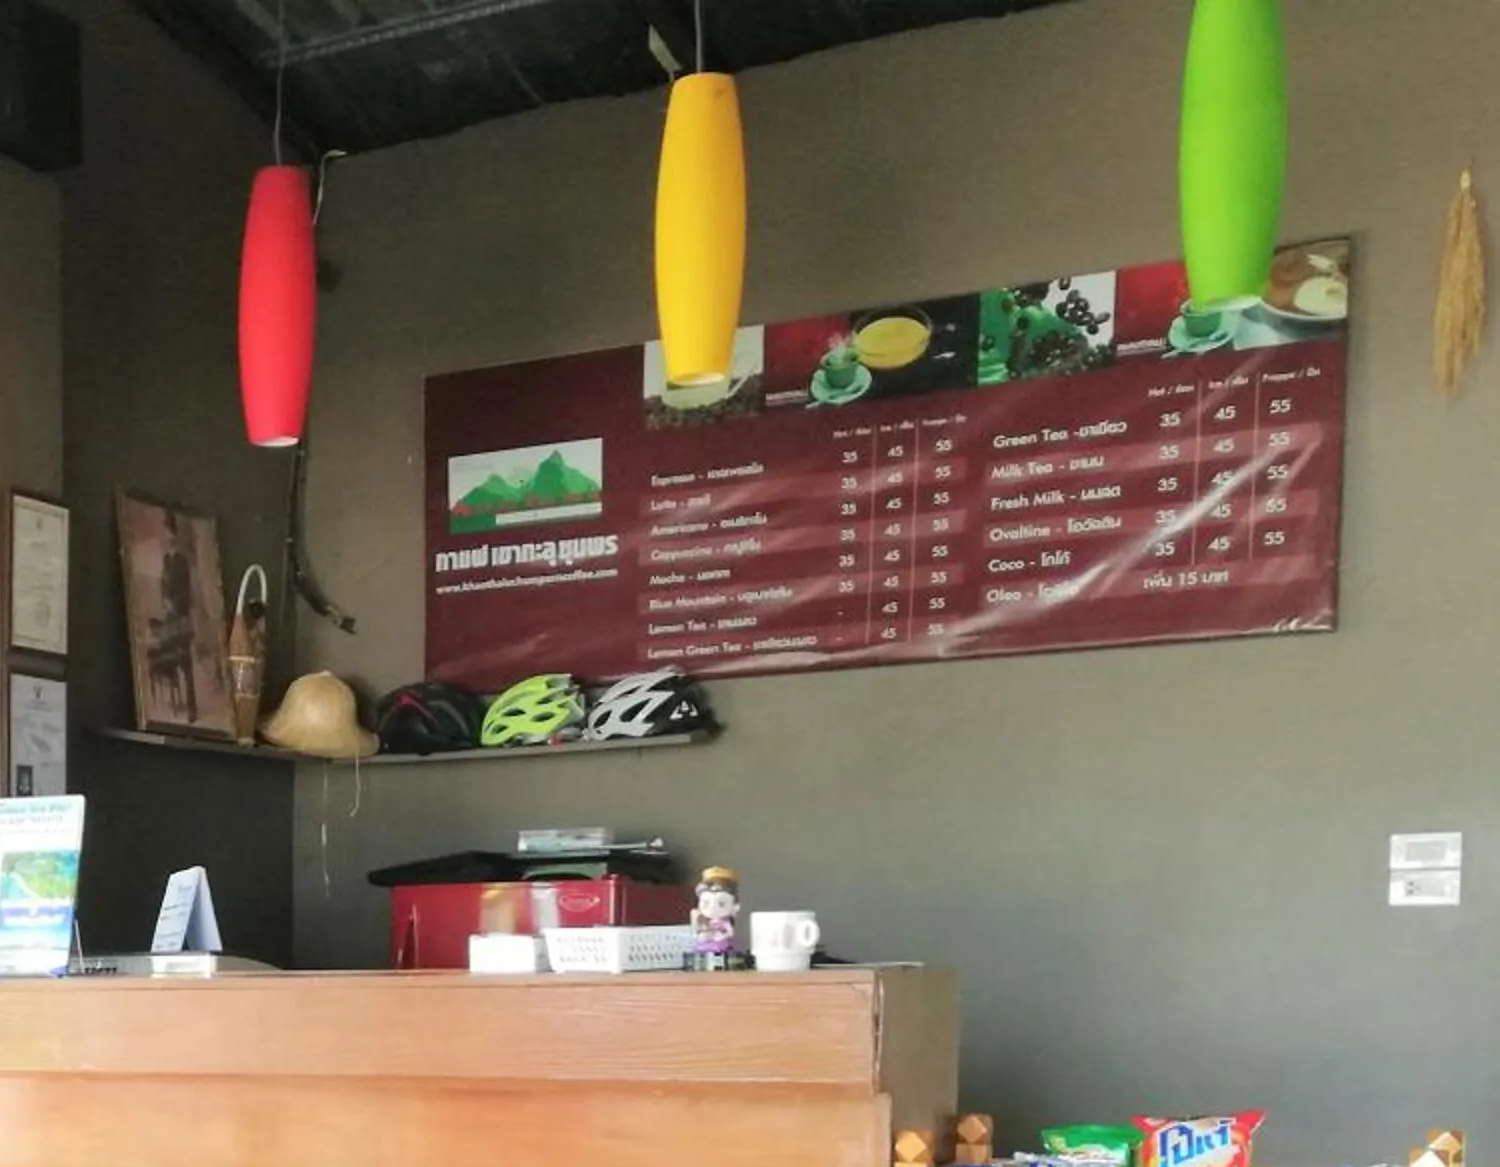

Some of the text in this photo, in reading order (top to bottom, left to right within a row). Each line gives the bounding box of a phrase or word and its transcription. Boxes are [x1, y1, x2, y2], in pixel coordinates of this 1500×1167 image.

[1159, 398, 1292, 427] 35 45 55
[993, 435, 1037, 448] Green
[1041, 428, 1068, 441] Tea
[1158, 431, 1290, 460] 35 45 55
[842, 451, 858, 463] 35
[888, 445, 904, 457] 45
[991, 463, 1024, 479] Milk
[1028, 461, 1053, 475] Tea
[1157, 464, 1289, 491] 35 45 55
[841, 477, 857, 489] 35
[887, 471, 903, 483] 45
[841, 503, 857, 515] 35
[885, 497, 902, 509] 45
[990, 493, 1029, 510] Fresh
[1033, 489, 1065, 506] Milk
[1210, 503, 1231, 518] 45
[839, 528, 855, 541] 35
[884, 523, 901, 536] 45
[989, 525, 1051, 542] Ovaltine
[1155, 530, 1285, 556] 35 45 55
[838, 554, 855, 567] 35
[883, 550, 900, 562] 45
[988, 559, 1025, 572] Coco
[838, 580, 854, 593] 35
[883, 575, 899, 588] 45
[1178, 571, 1197, 586] 15
[881, 601, 898, 613] 45
[880, 627, 897, 639] 45
